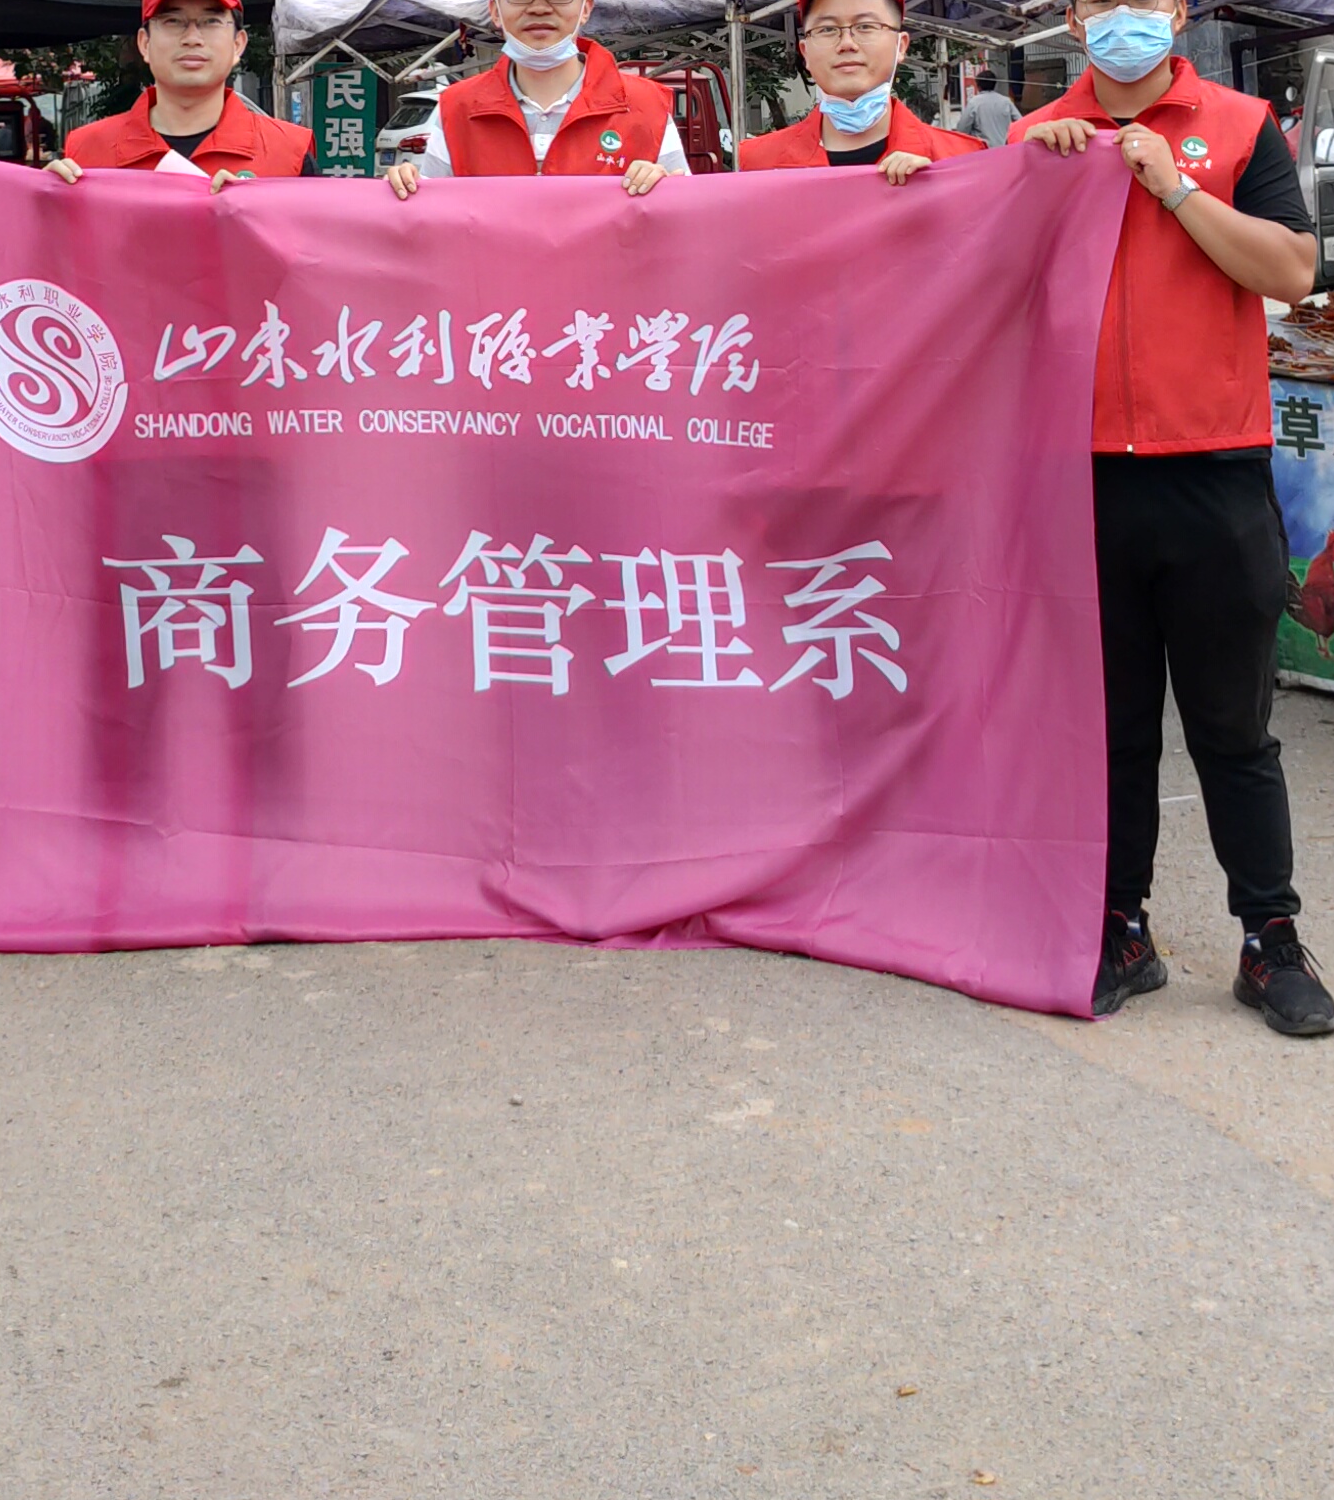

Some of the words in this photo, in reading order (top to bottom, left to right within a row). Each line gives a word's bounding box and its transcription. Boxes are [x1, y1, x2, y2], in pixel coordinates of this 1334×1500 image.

[135, 412, 252, 438] SHANDONG
[268, 409, 344, 434] WATER
[358, 409, 521, 436] CONSERVANCY
[536, 413, 673, 441] VOCATIONAL
[687, 417, 774, 449] COLLEGE
[102, 525, 908, 701] 商务管理系
